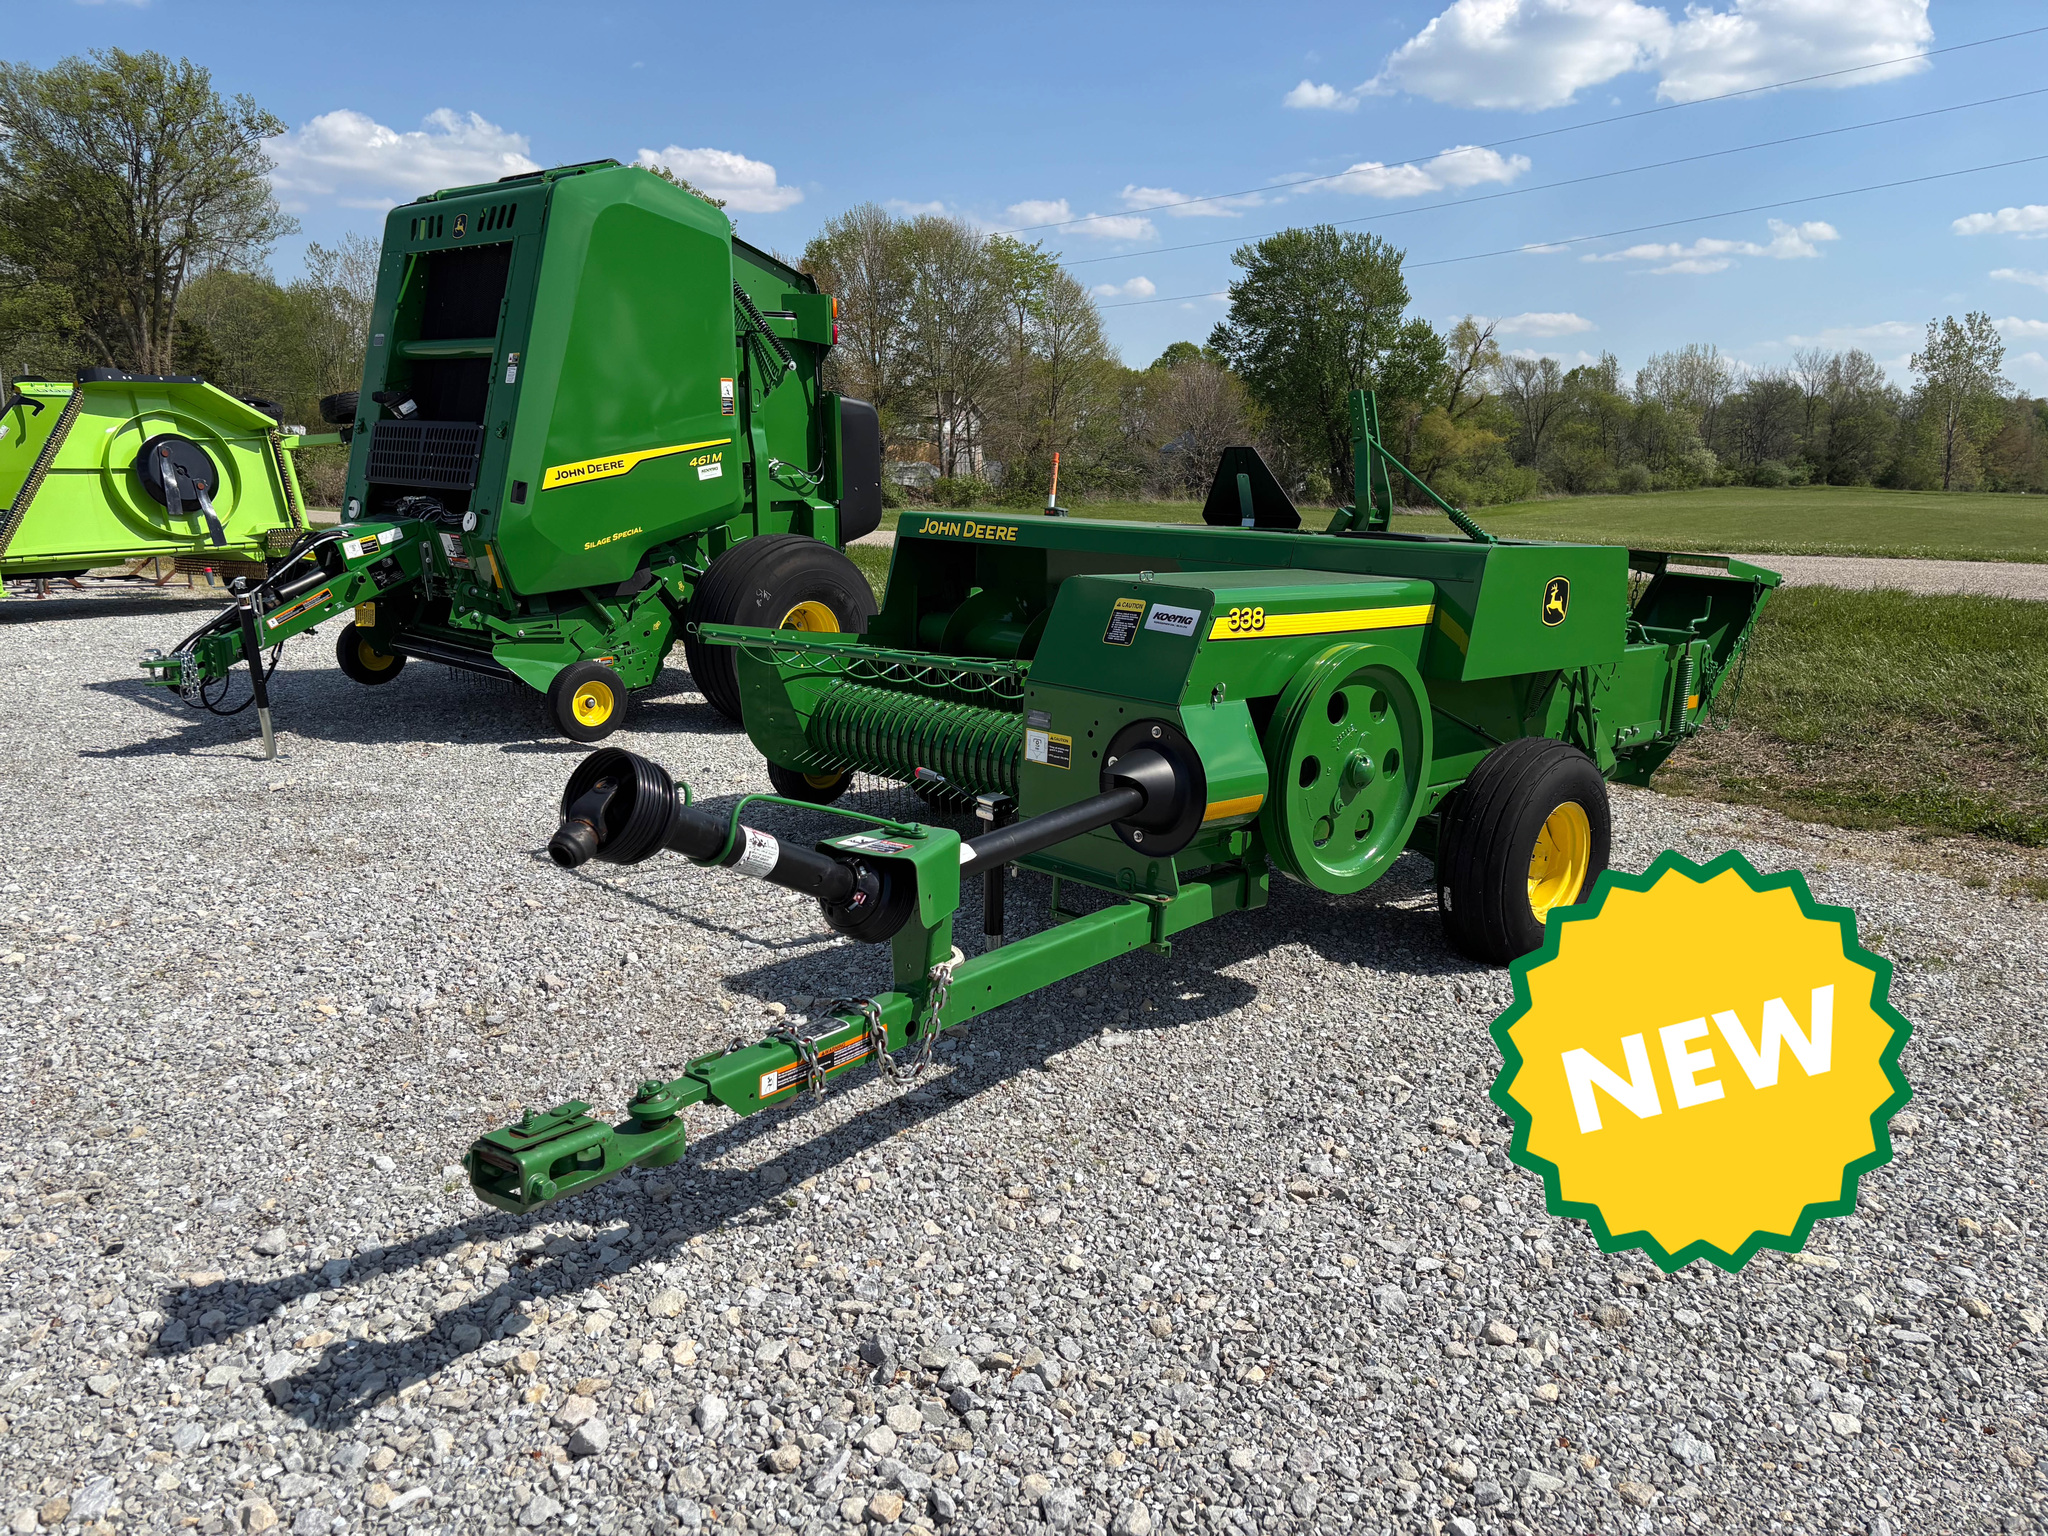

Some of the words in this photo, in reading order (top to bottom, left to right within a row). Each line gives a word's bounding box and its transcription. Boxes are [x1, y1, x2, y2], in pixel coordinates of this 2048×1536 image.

[554, 468, 586, 481] JOHN
[587, 460, 625, 474] DEERE
[584, 537, 612, 551] SILAGE
[612, 526, 643, 542] SPECIAL
[919, 518, 961, 537] JOHN
[963, 521, 1019, 542] DEERE
[1121, 602, 1144, 610] CAUTION
[1228, 606, 1265, 632] 338
